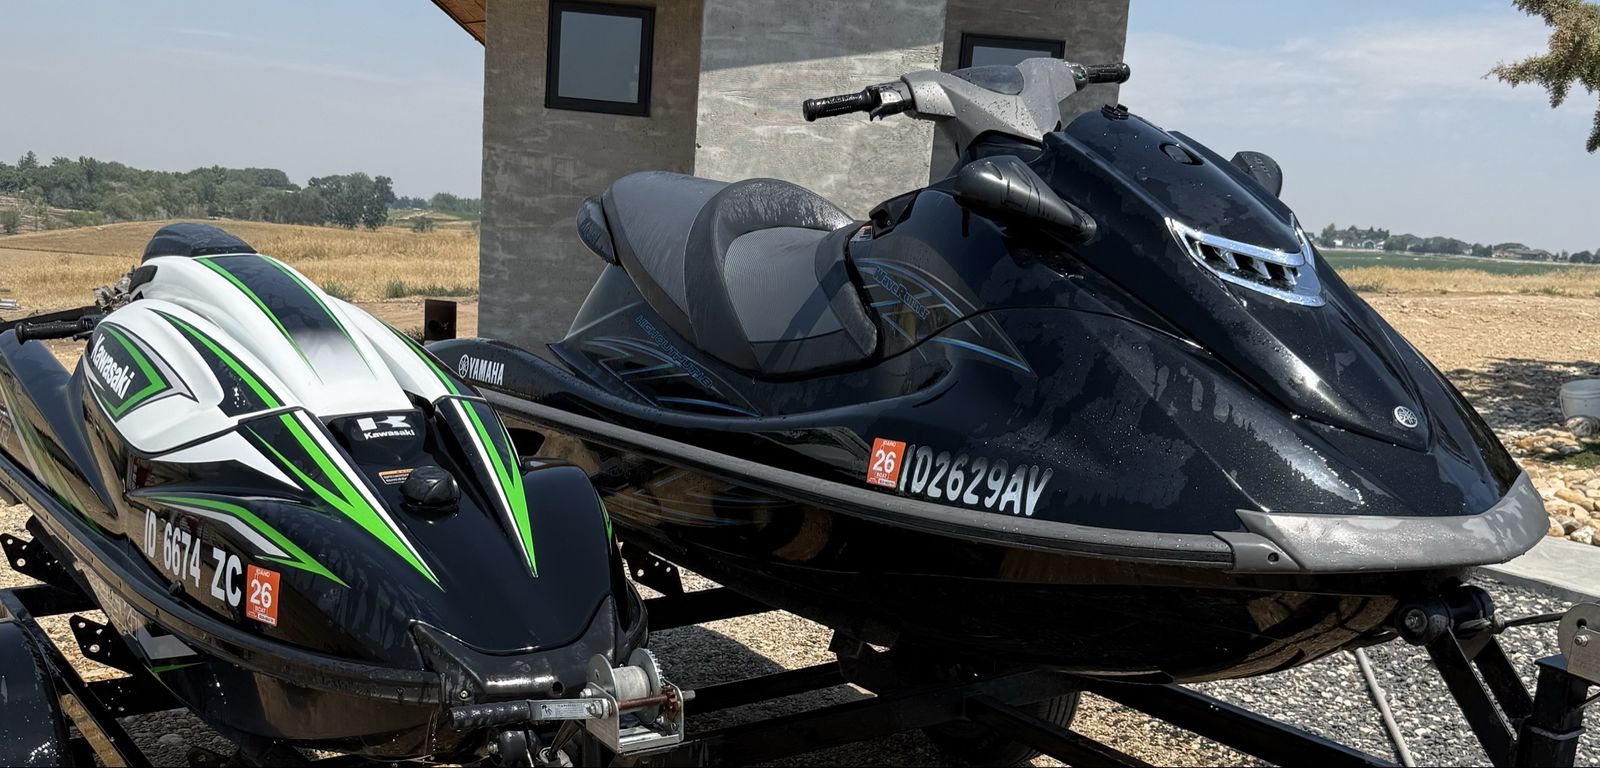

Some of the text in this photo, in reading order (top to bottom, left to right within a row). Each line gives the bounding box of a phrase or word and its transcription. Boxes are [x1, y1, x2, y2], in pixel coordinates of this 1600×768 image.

[872, 266, 930, 321] WaveRunner
[90, 333, 136, 400] Kawasaki
[469, 356, 505, 386] YAMAHA
[363, 429, 416, 440] Kawasaki
[873, 449, 897, 473] 26
[899, 443, 1054, 516] ID2629AV
[144, 508, 243, 608] ID 6674 ZC
[251, 579, 272, 608] 26
